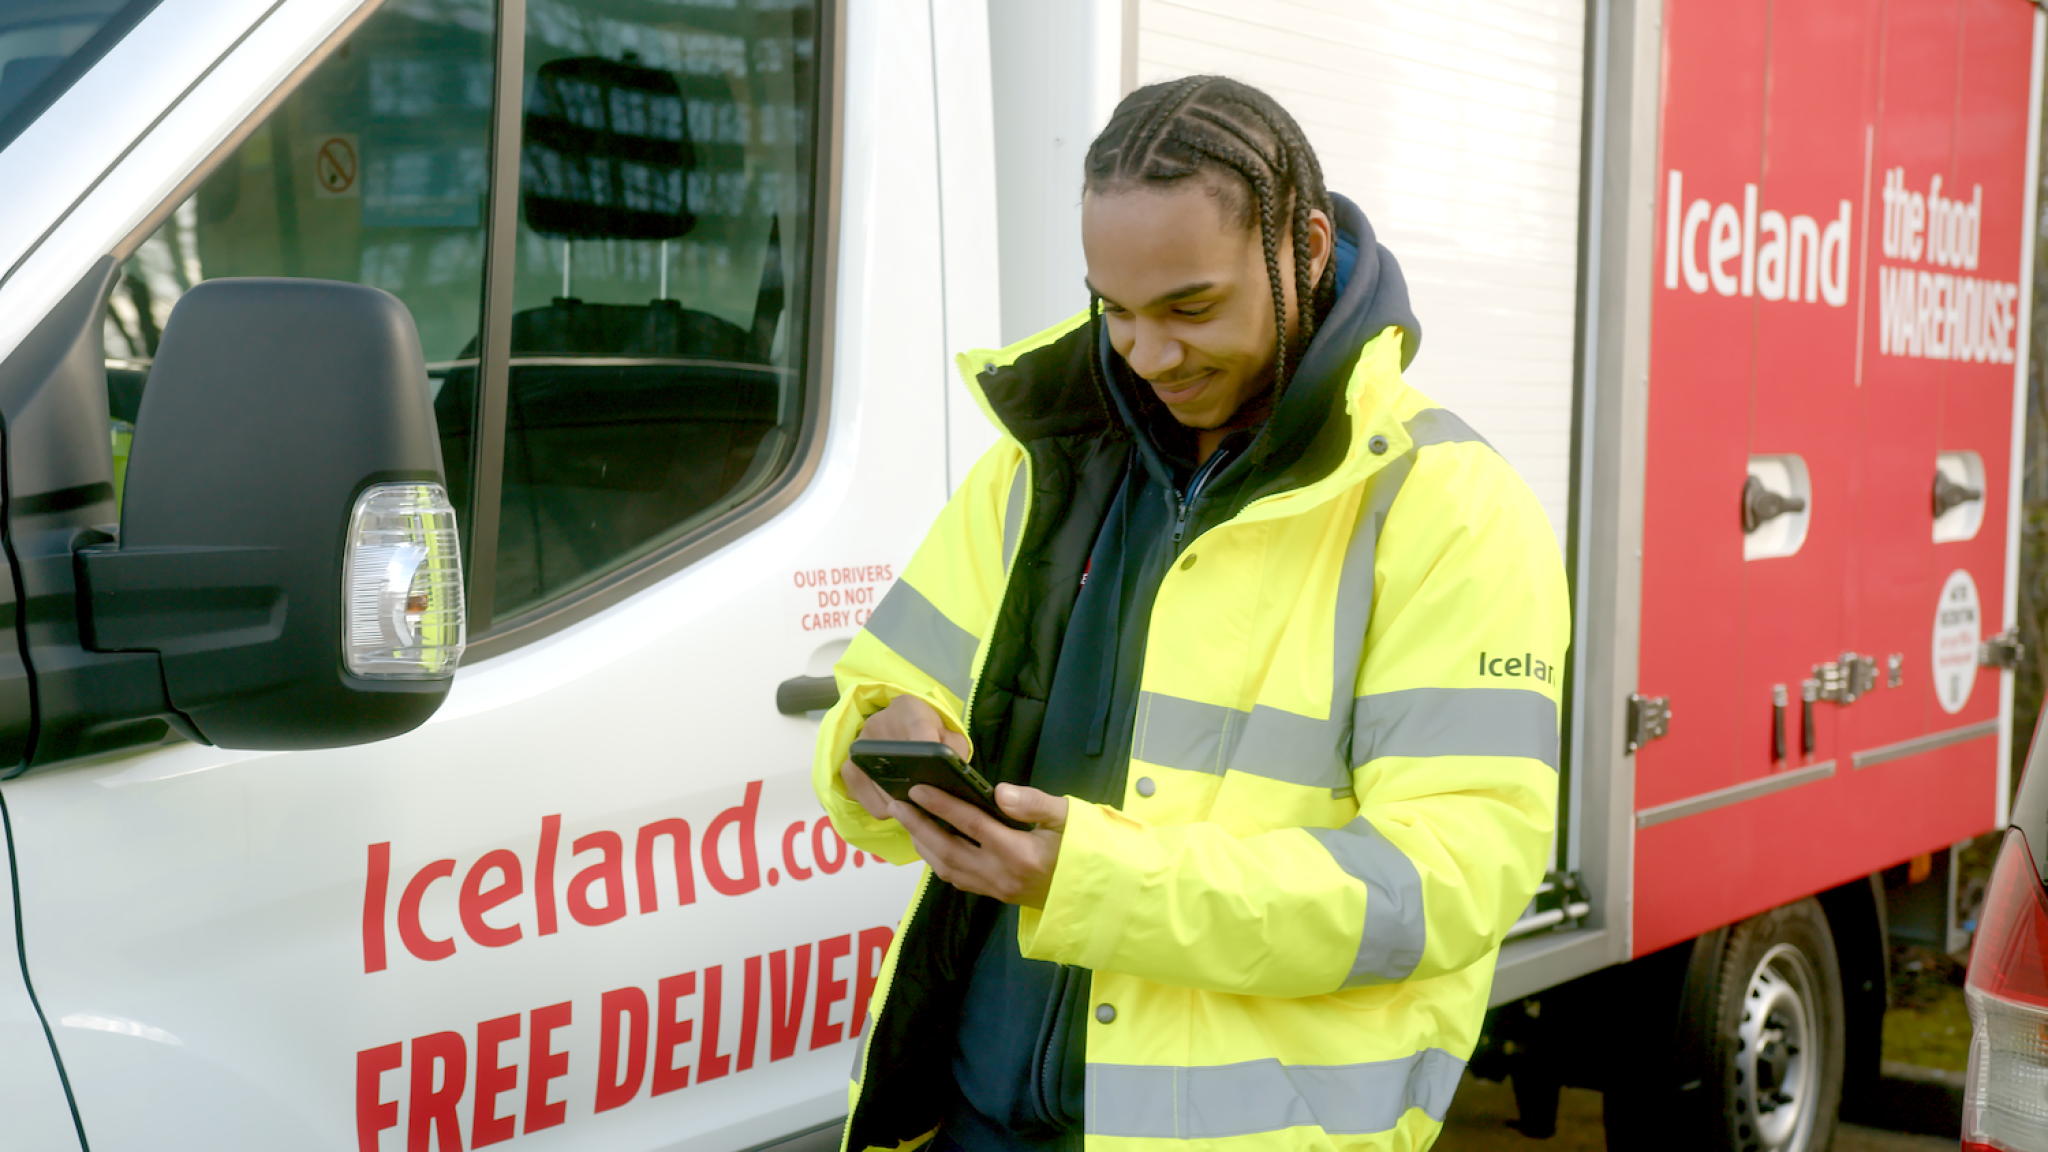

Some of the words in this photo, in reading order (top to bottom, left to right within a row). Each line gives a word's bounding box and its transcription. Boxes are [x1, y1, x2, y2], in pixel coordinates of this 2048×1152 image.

[1664, 169, 1851, 307] Iceland
[1882, 167, 1924, 261] the
[1926, 173, 1982, 270] food
[1879, 265, 2017, 364] WAREHOUSE
[794, 569, 827, 588] OUR
[830, 564, 893, 585] DRIVERS
[802, 610, 850, 631] CARRY
[818, 590, 841, 608] DO
[844, 587, 874, 606] NOT
[361, 779, 888, 974] Iceland.co.
[355, 1000, 572, 1152] FREE
